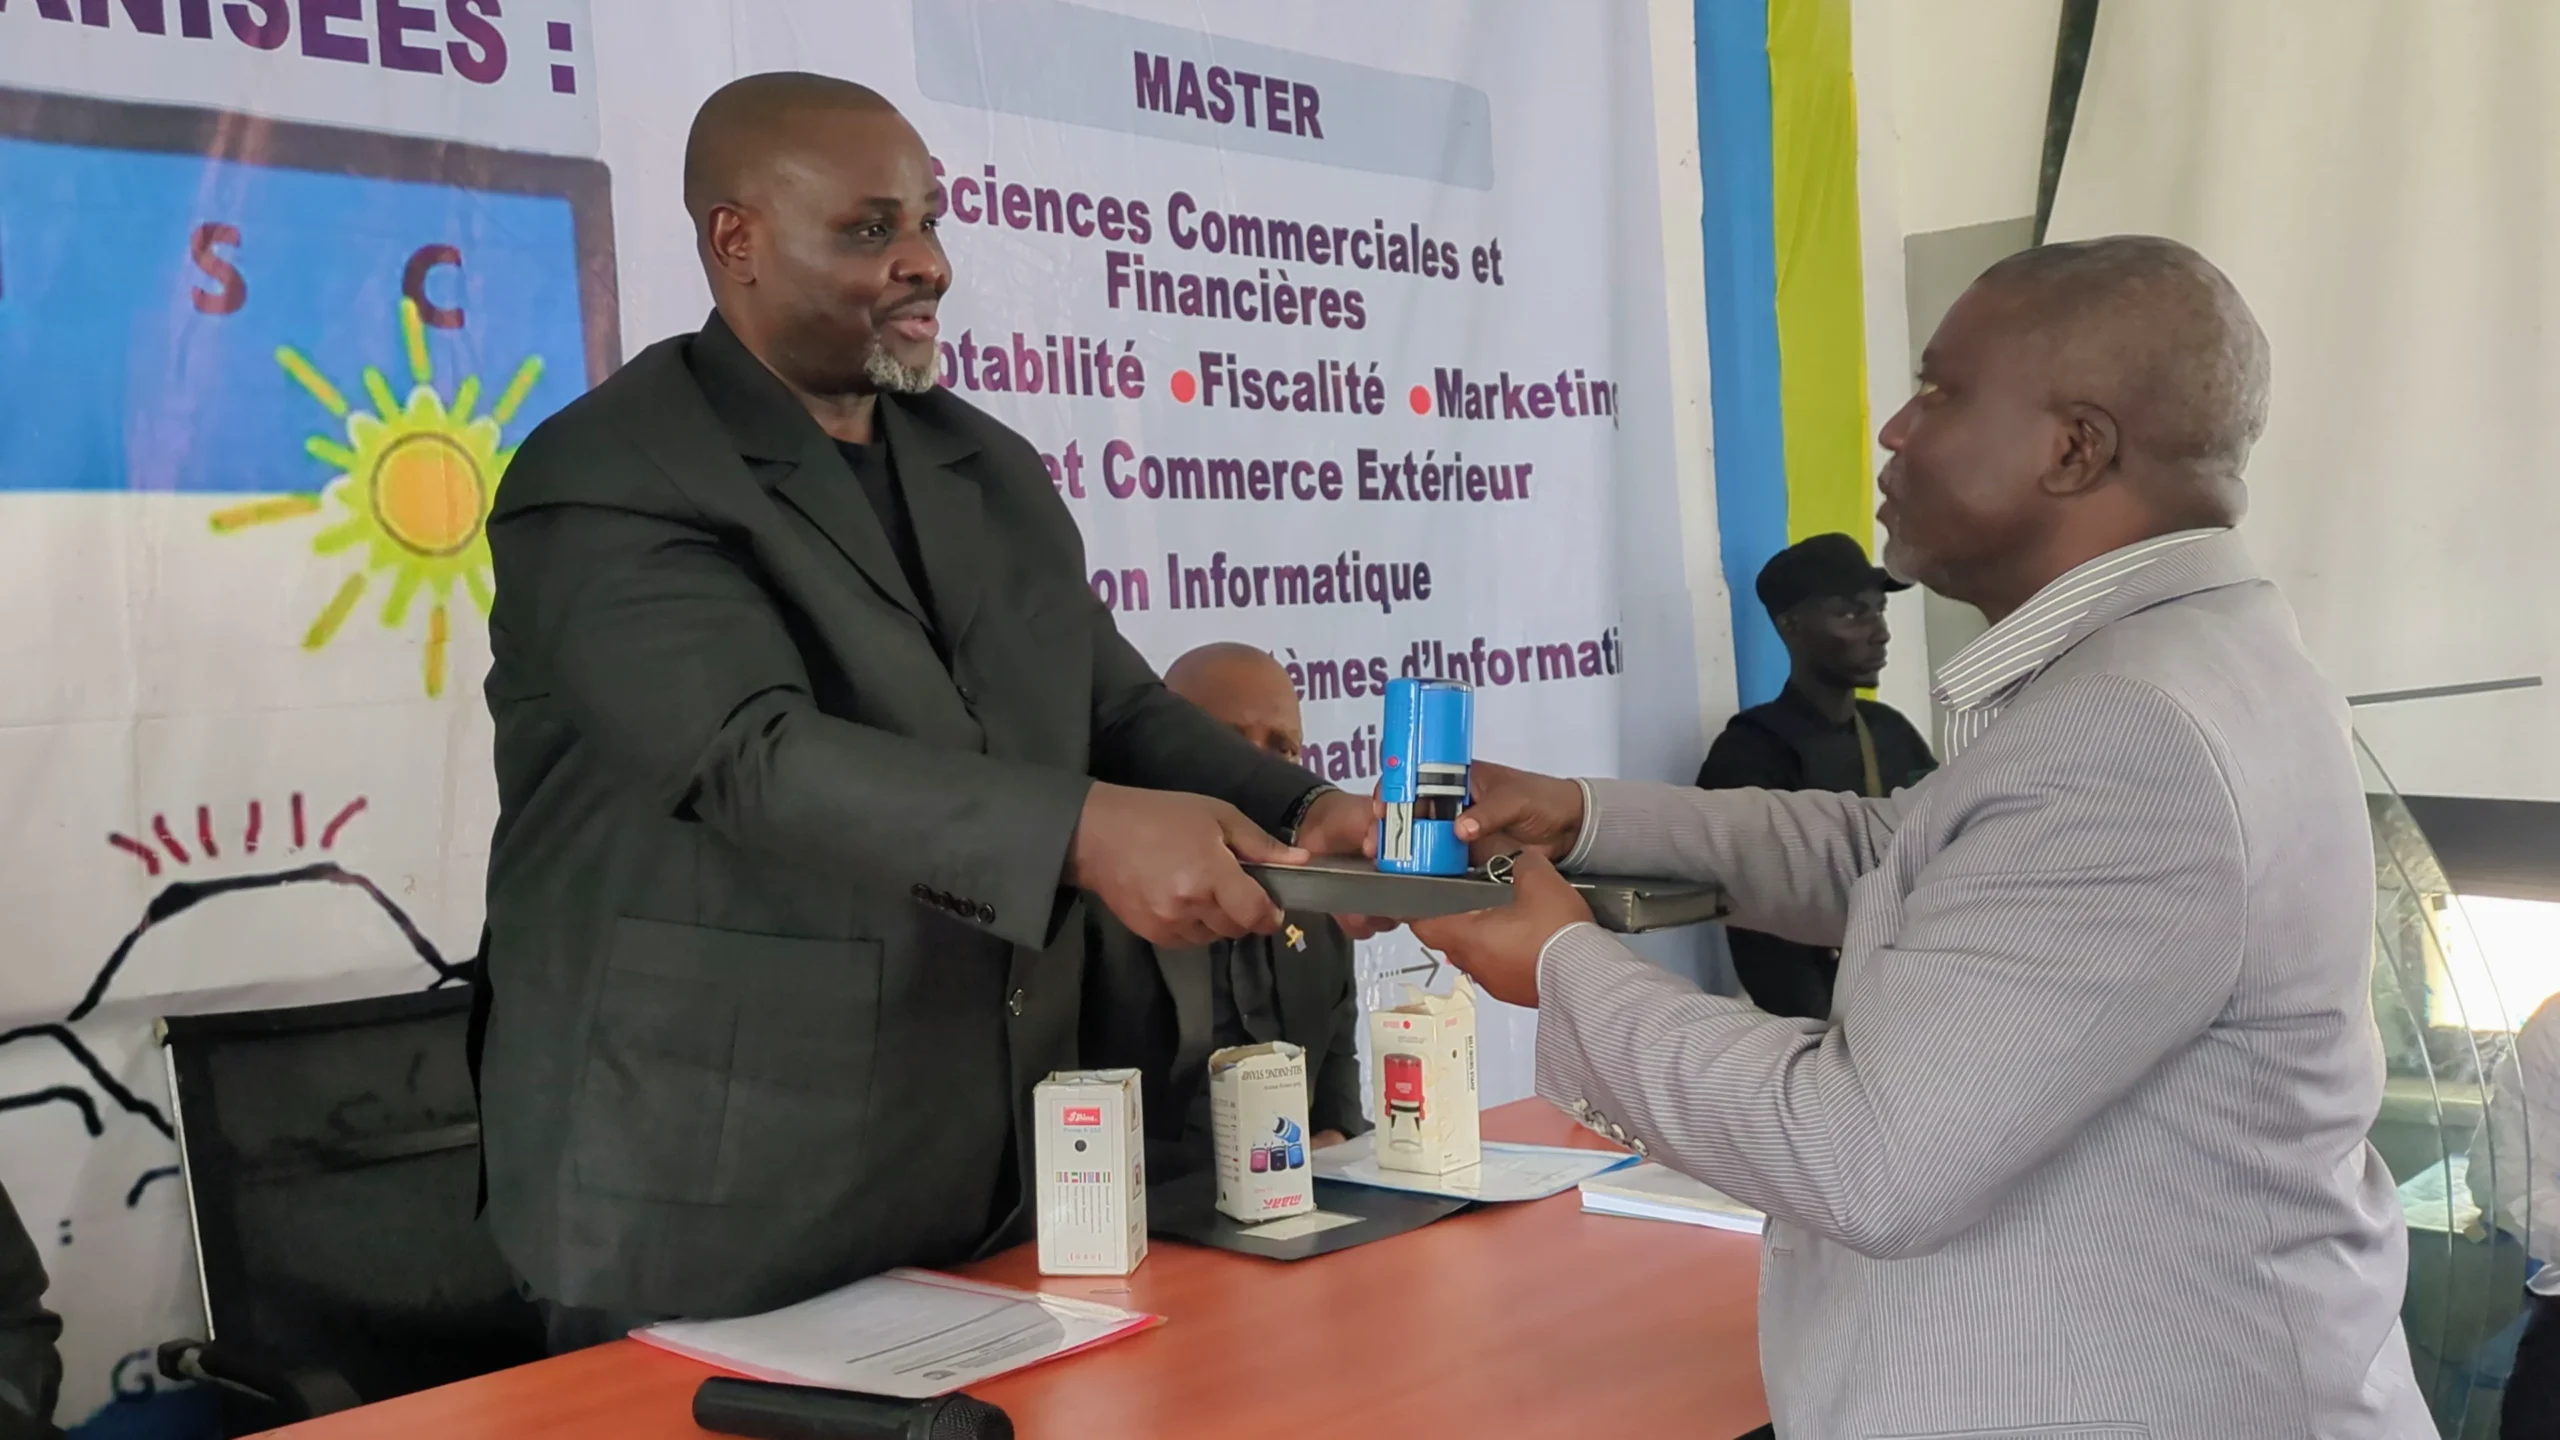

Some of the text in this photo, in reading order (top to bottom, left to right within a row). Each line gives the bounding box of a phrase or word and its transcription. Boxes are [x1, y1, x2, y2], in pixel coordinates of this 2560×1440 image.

[0, 0, 508, 84] SEES
[1134, 51, 1324, 139] MASTER
[190, 222, 466, 329] S C
[1167, 191, 1460, 280] Commerciales
[1471, 237, 1504, 286] et
[1106, 250, 1366, 330] Financières
[1199, 350, 1385, 416] Fiscalité
[1103, 439, 1343, 501] Commerce
[1356, 447, 1533, 502] Extérieur
[1167, 550, 1432, 614] Informatique
[1269, 626, 1624, 701] èmes d’Informati
